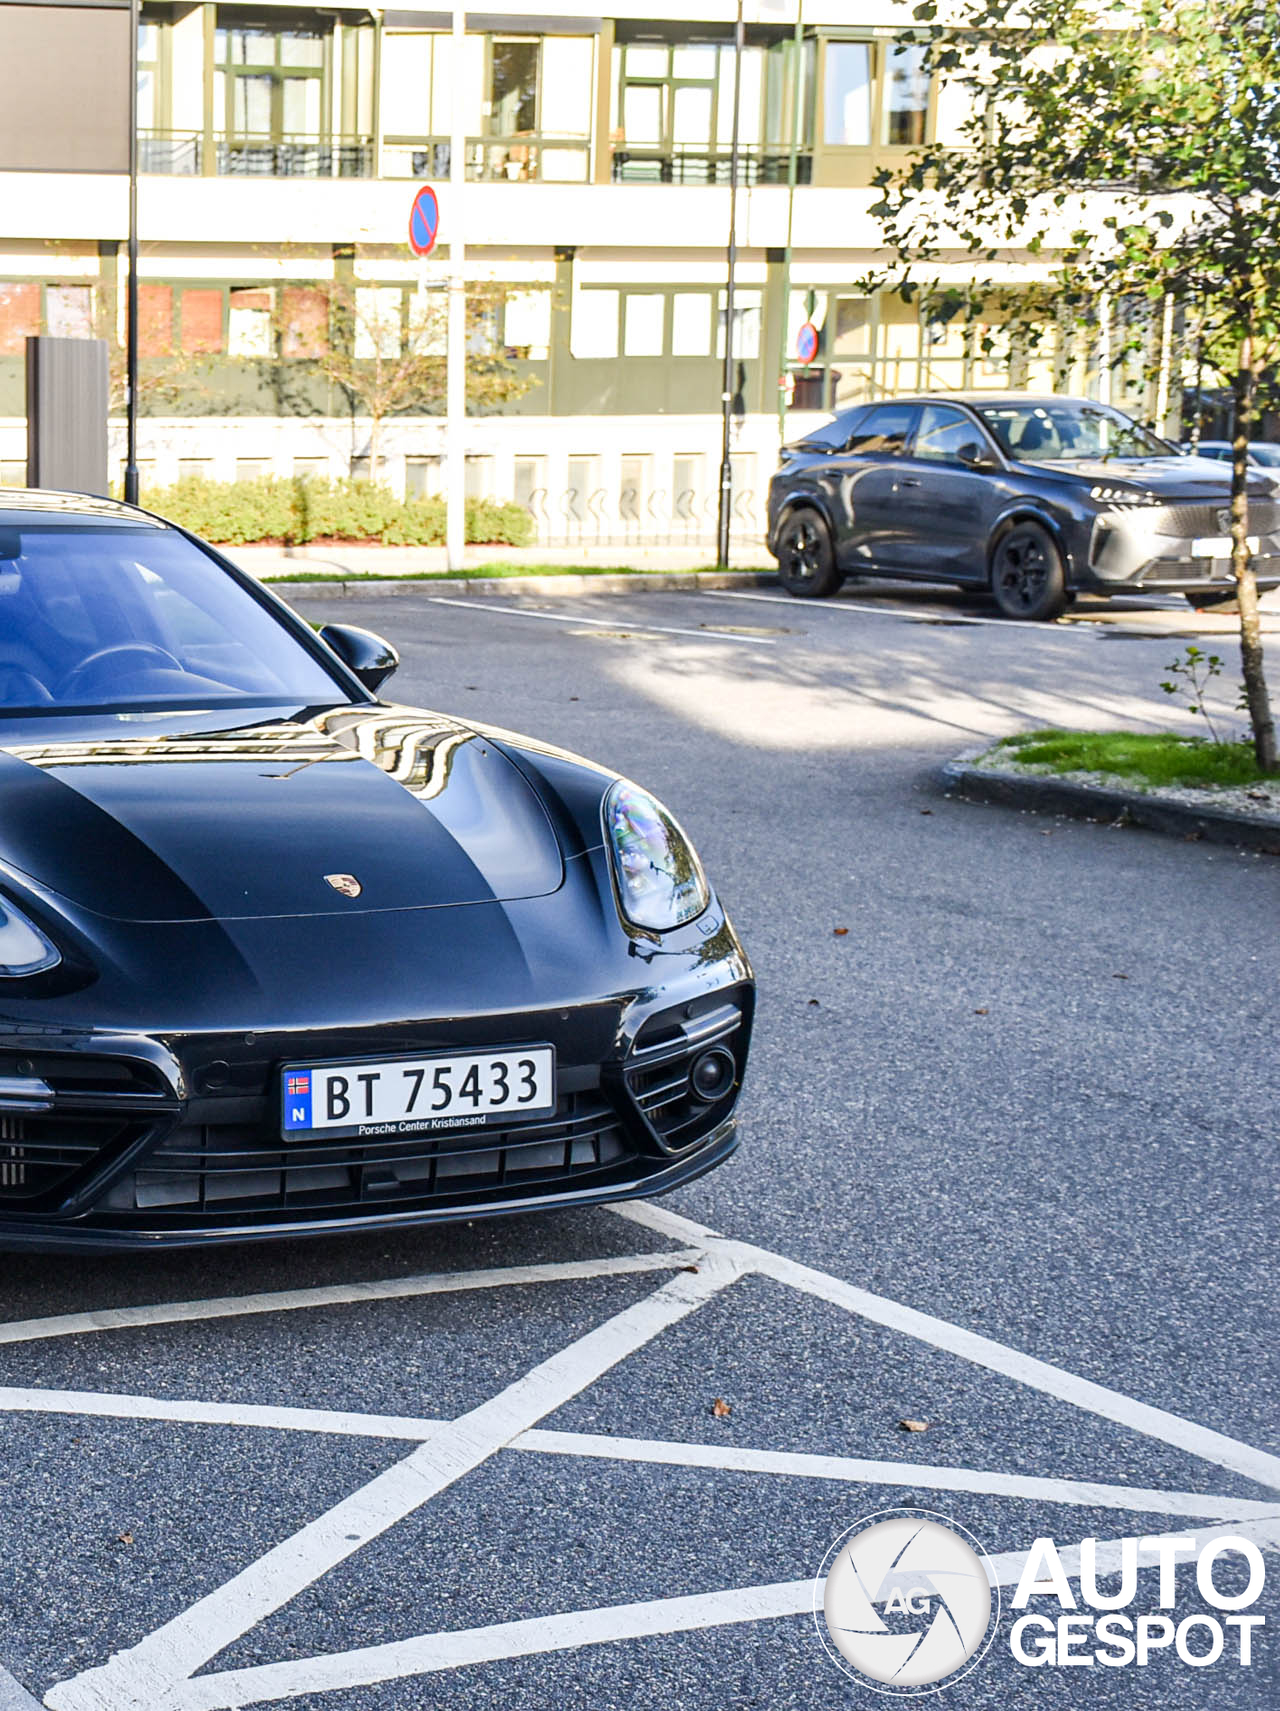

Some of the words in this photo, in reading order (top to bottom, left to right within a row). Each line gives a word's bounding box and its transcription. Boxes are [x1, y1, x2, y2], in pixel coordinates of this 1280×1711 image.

[326, 1072, 381, 1120] BT
[402, 1059, 538, 1113] 75433
[292, 1107, 305, 1122] N
[358, 1125, 396, 1136] Porsche
[398, 1121, 428, 1132] Center
[431, 1115, 487, 1129] Kristiansand
